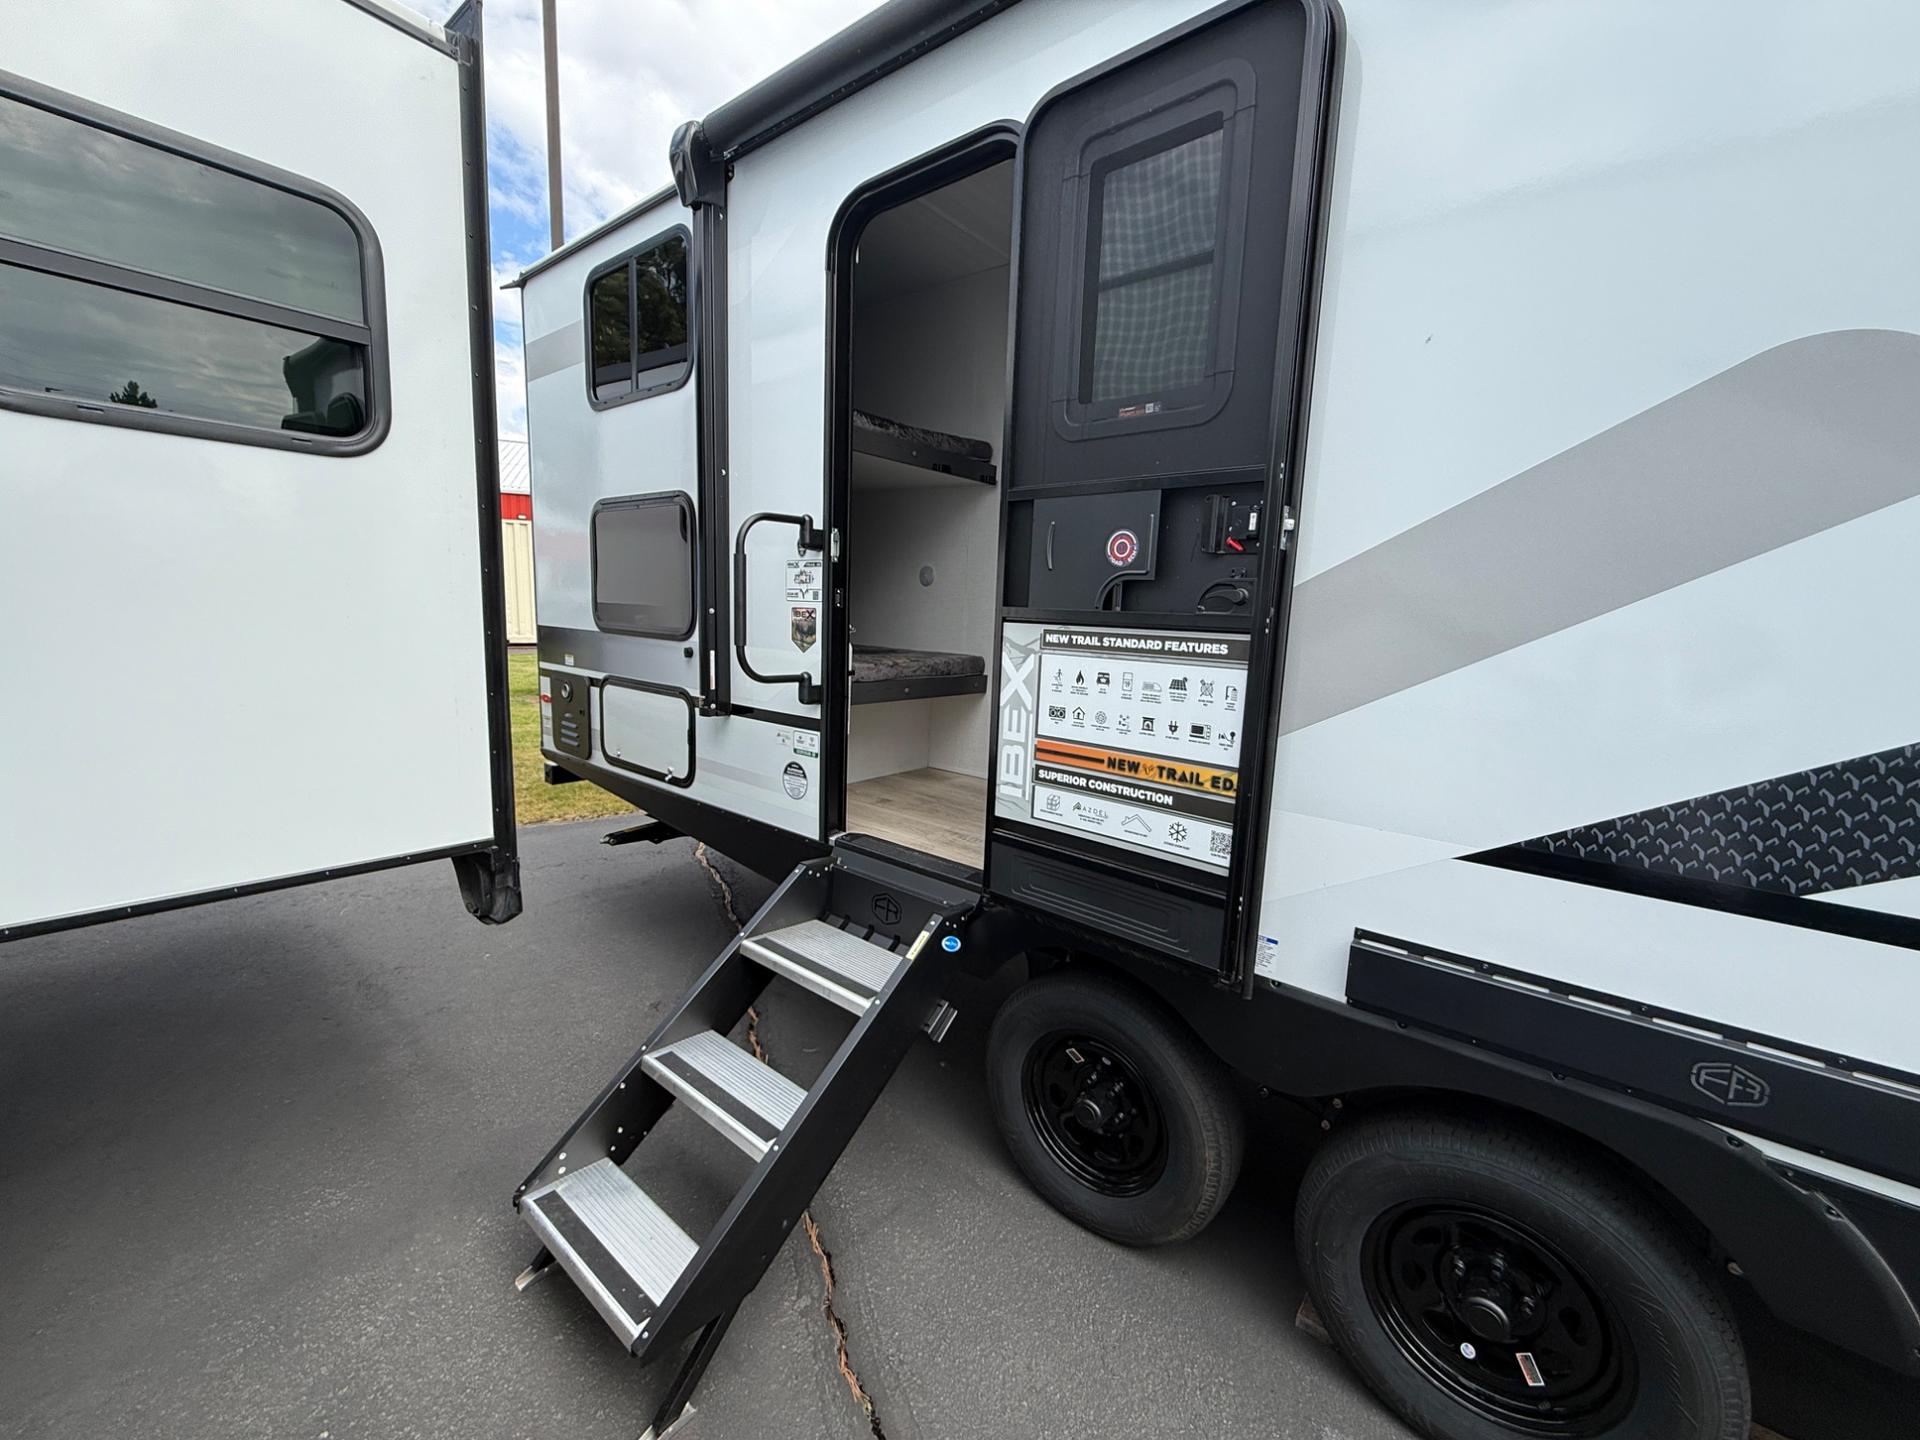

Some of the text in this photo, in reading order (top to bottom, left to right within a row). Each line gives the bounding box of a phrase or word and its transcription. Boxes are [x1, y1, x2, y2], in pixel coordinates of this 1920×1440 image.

[1045, 633, 1229, 655] NEW TRAIL STANDARD FEATURES
[1001, 653, 1034, 798] IBEX
[1038, 768, 1174, 806] SUPERIOR CONSTRUCTION
[1106, 756, 1141, 774] NEW
[1156, 765, 1204, 787] TRAIL
[1082, 805, 1109, 819] AZDEL
